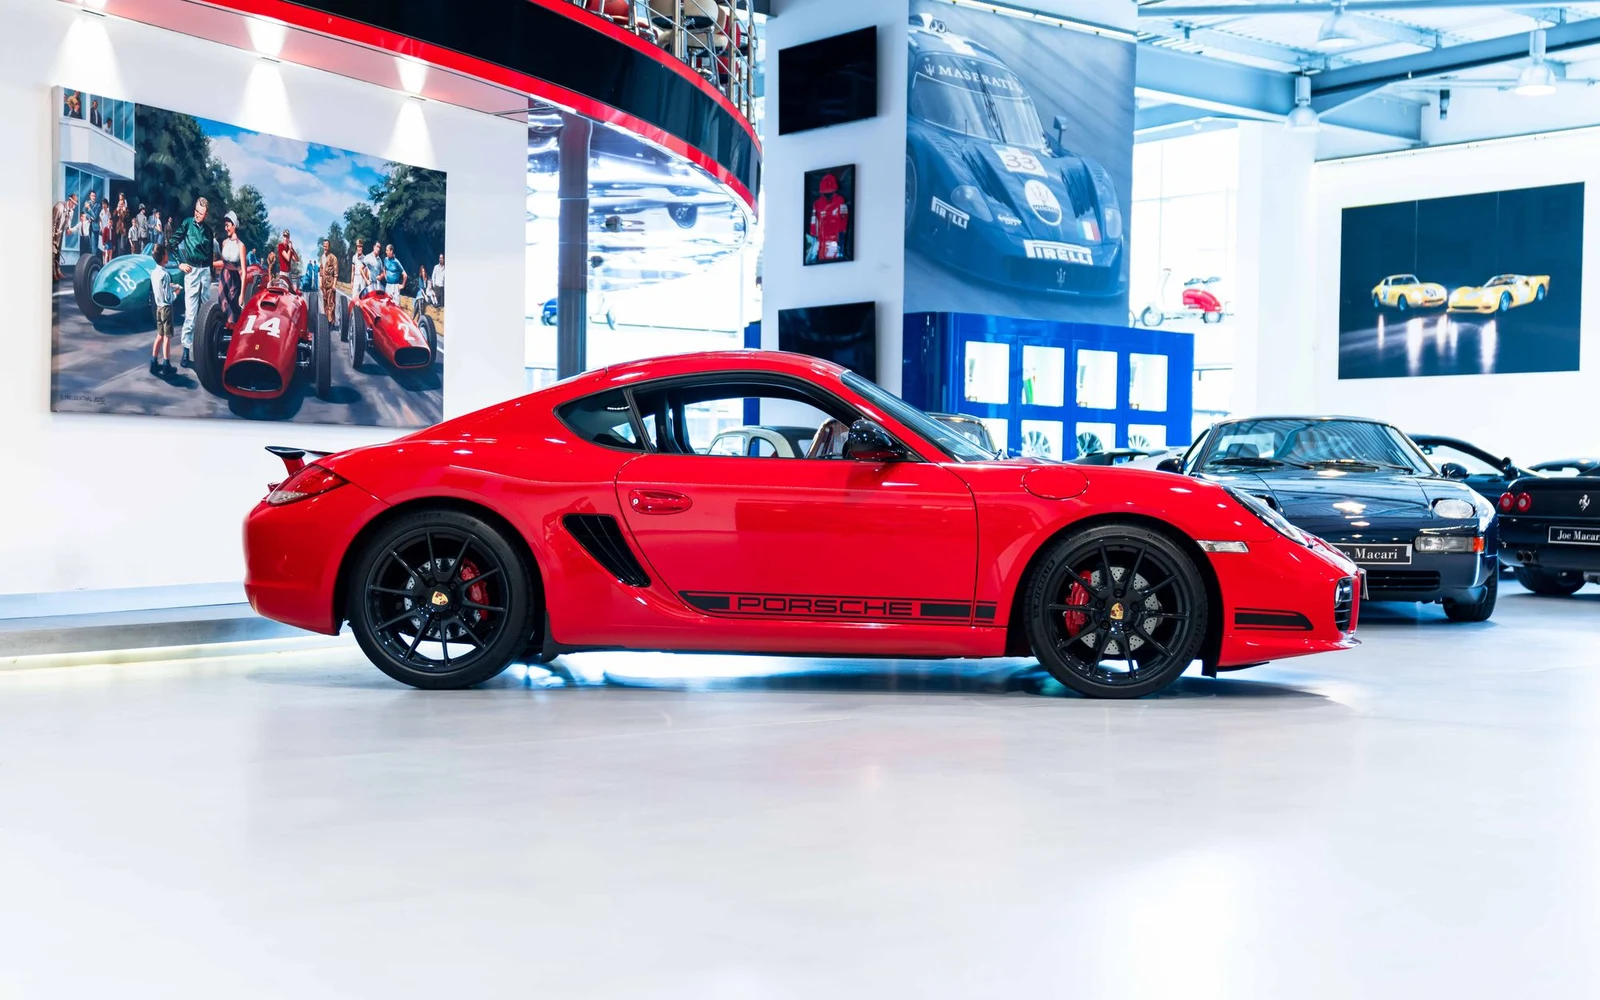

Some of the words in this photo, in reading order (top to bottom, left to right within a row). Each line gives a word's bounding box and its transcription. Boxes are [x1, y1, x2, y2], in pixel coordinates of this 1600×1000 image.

[938, 65, 1013, 92] MASERATI
[1005, 155, 1037, 171] 33
[1023, 239, 1094, 266] PIRELLI
[114, 272, 136, 292] 18
[240, 314, 281, 338] 14
[1557, 530, 1572, 540] Joe
[1574, 530, 1600, 541] Macar
[1354, 547, 1398, 560] Macari
[737, 596, 913, 616] PORSCHE
